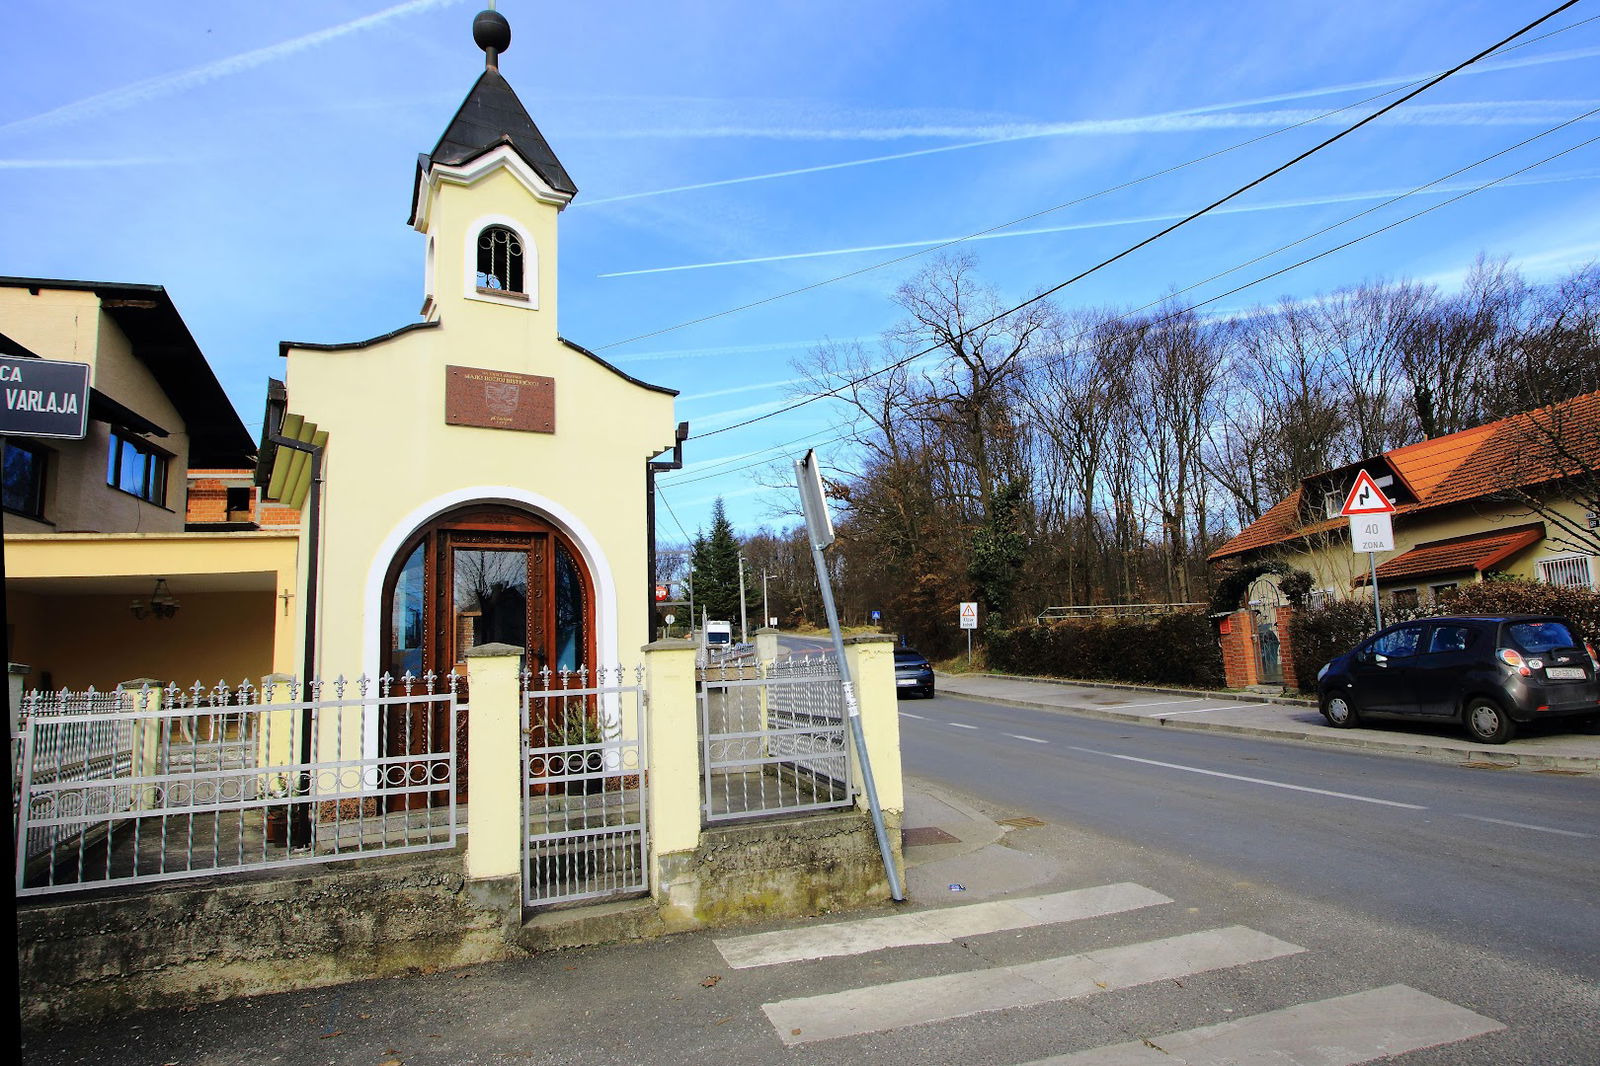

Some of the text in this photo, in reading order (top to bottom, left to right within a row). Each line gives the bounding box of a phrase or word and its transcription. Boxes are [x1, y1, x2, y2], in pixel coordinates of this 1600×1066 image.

[6, 388, 77, 414] VARLAJA
[1365, 523, 1379, 535] 40
[1362, 541, 1384, 550] ZONA
